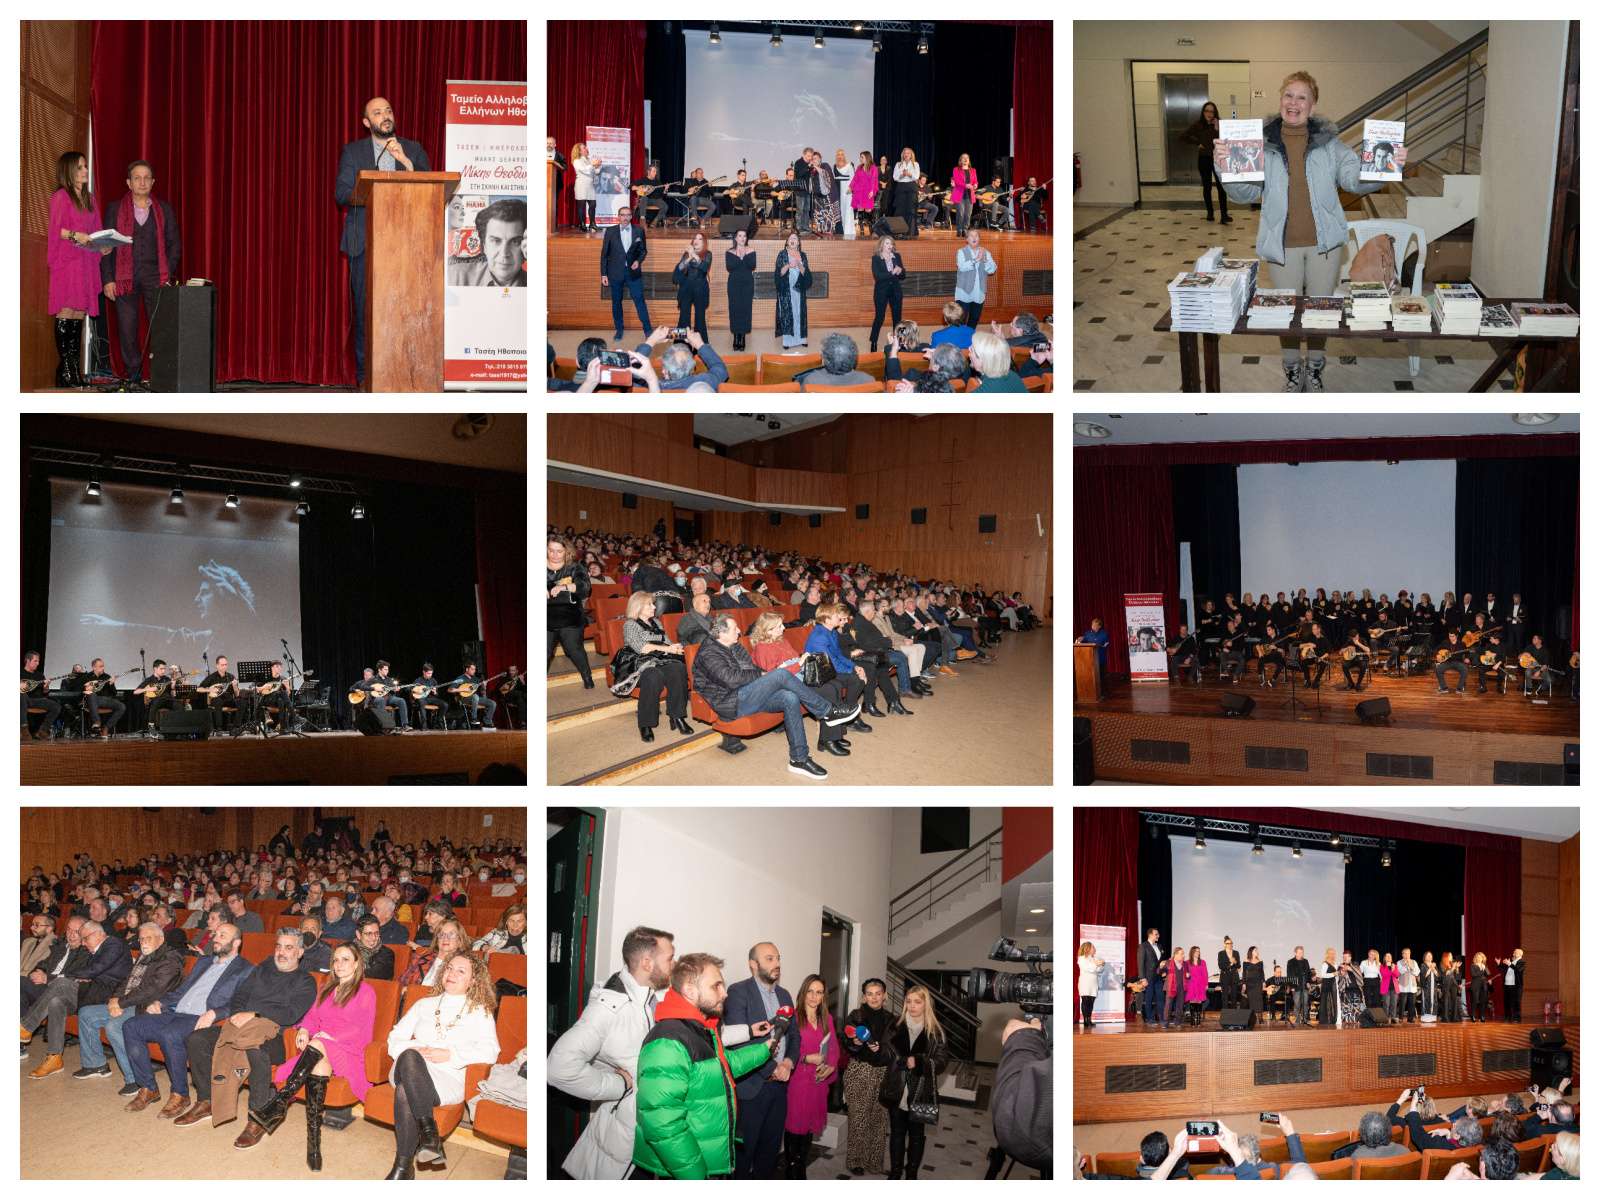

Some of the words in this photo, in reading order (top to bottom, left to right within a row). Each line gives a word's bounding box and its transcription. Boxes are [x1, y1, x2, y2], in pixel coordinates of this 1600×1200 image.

[450, 94, 483, 105] Ταμείο
[459, 106, 504, 117] Ελλήνων
[507, 107, 527, 116] Ηθο
[463, 165, 491, 179] Μίκης
